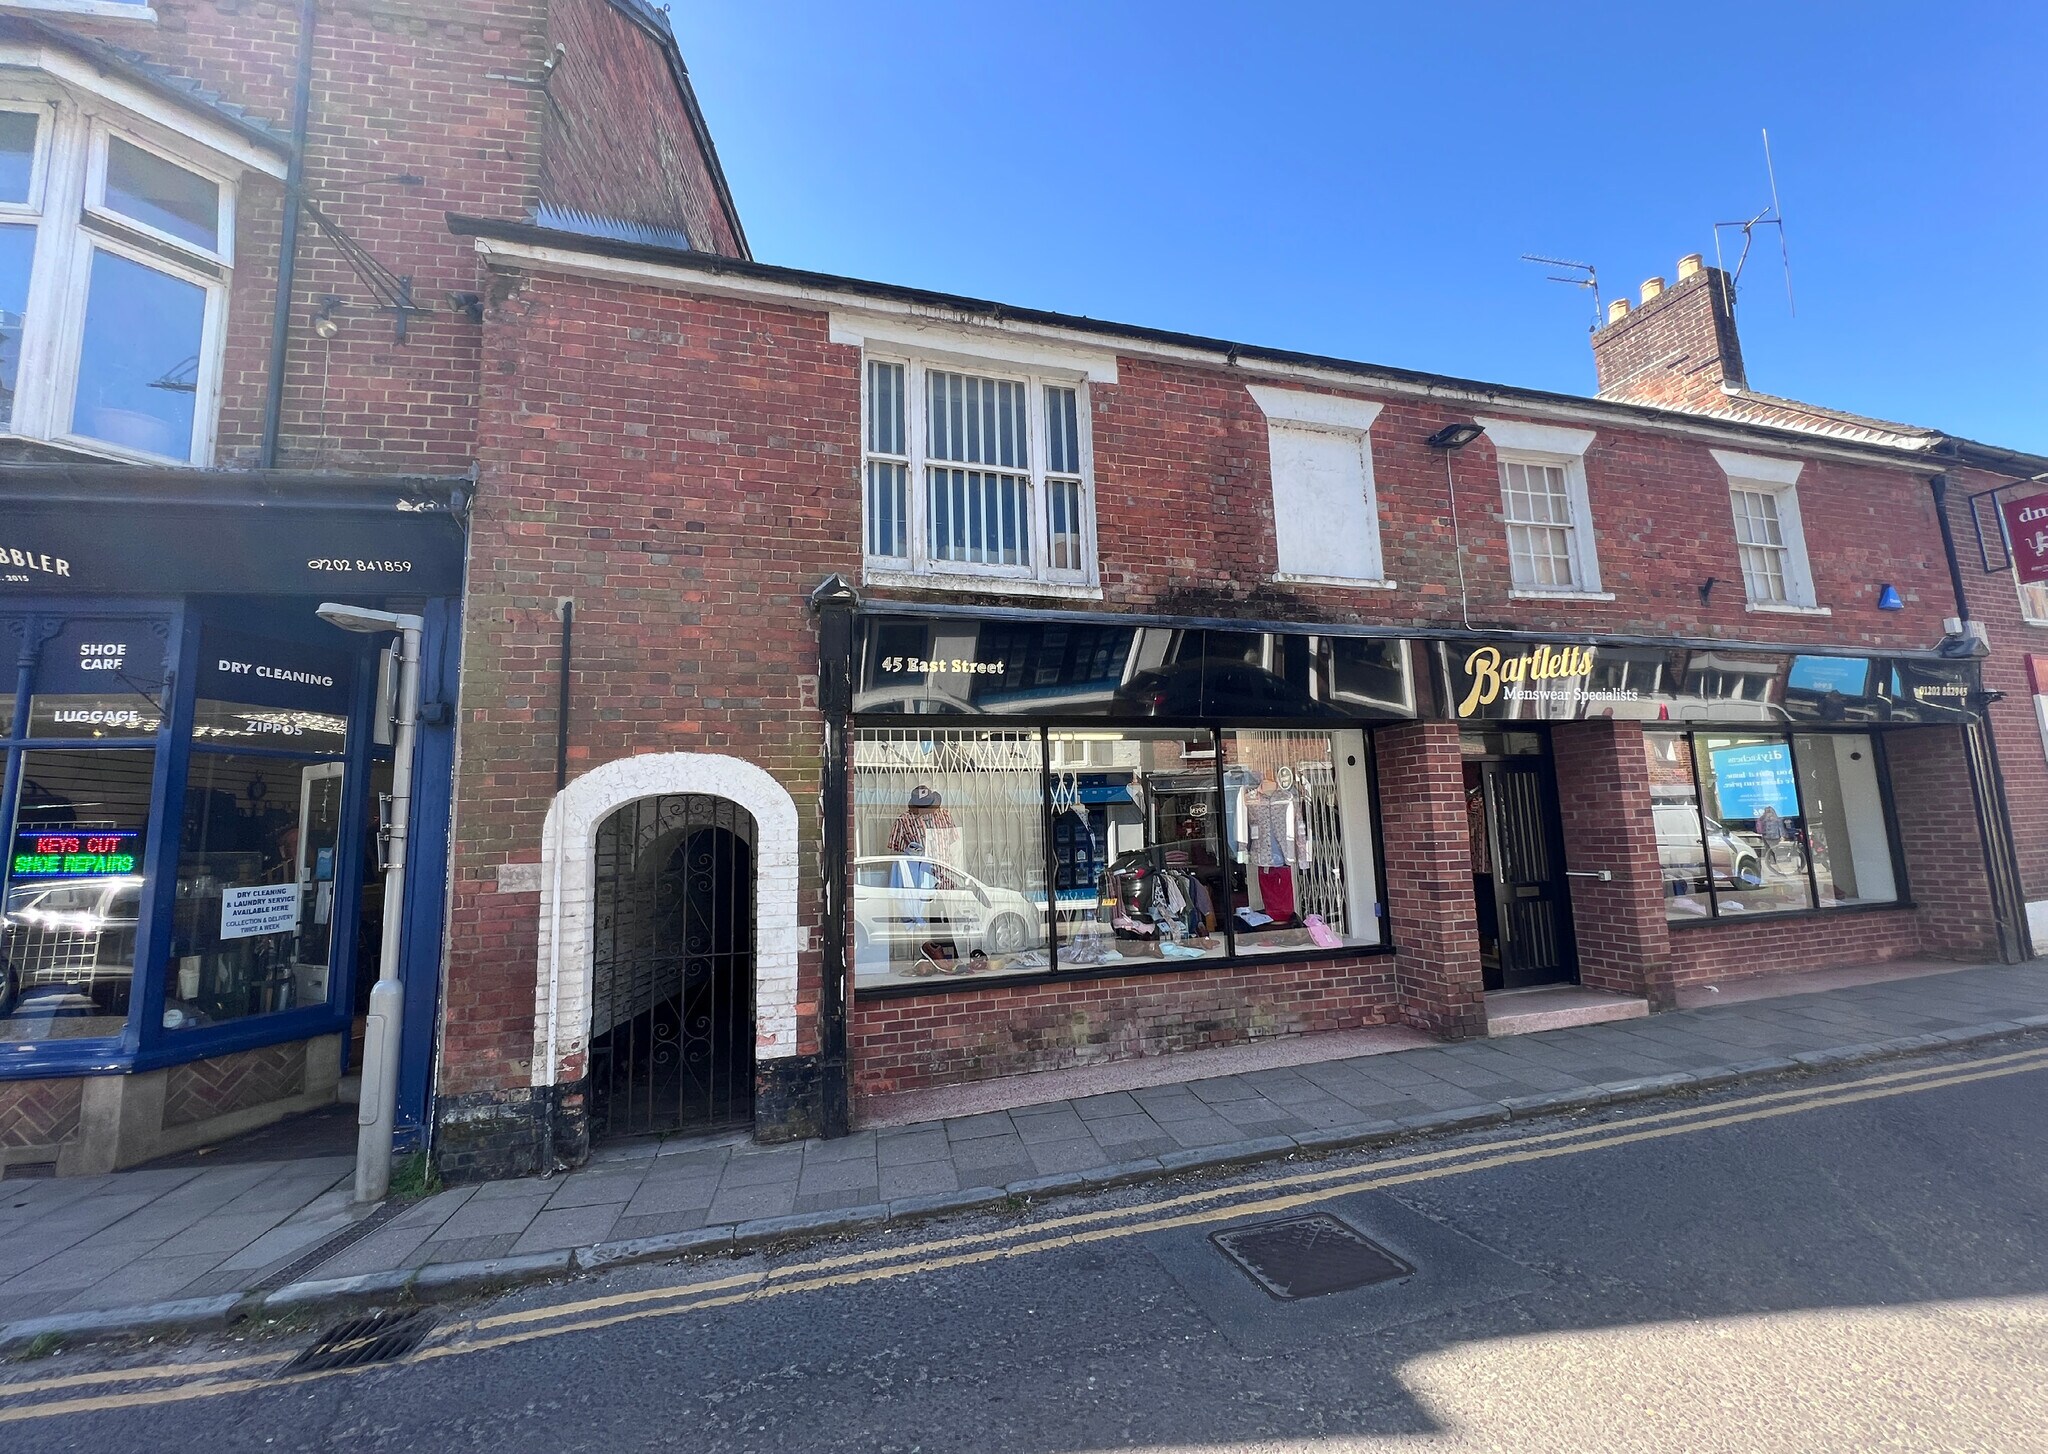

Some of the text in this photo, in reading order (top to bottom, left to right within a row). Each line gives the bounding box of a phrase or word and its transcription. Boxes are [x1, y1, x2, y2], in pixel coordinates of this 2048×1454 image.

[356, 560, 411, 572] 841859
[80, 644, 126, 656] SHOE
[80, 658, 122, 670] CARE
[881, 656, 1004, 674] 45 East Street
[218, 659, 333, 687] DRY CLEANING
[1458, 646, 1593, 718] Bartletts
[1503, 686, 1638, 705] Menswear Specialists
[54, 710, 138, 722] LUGGAGE
[245, 721, 303, 736] ZIPPOS
[37, 837, 121, 853] KEYS CUT
[15, 855, 134, 873] SHOE REPAIRS
[237, 888, 287, 899] DRY CLEANING
[234, 899, 266, 908] LAUNDRY
[268, 895, 295, 904] SERVICE
[232, 907, 270, 916] AVAILABLE
[226, 918, 262, 928] COLLECTION
[268, 914, 294, 923] DELIVERY
[241, 926, 258, 934] TWICE
